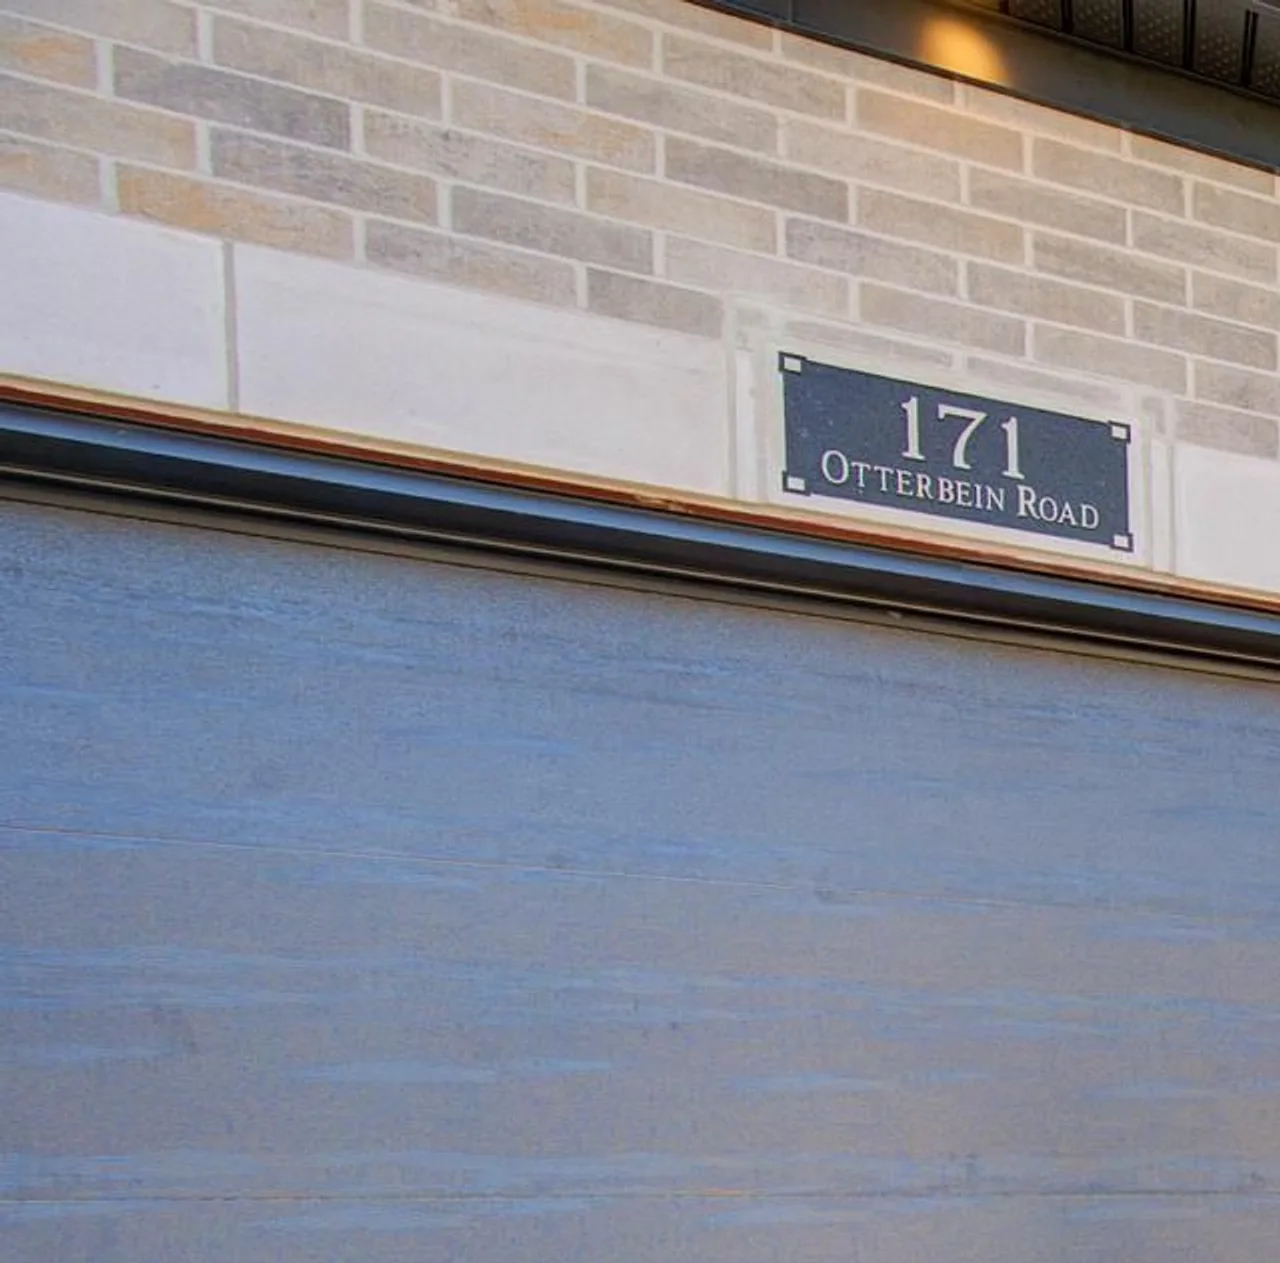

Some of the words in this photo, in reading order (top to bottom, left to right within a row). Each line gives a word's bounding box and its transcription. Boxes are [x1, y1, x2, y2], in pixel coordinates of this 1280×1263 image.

[902, 396, 1023, 479] 171
[821, 449, 1004, 512] OTTERBEIN
[1018, 485, 1100, 530] ROAD
